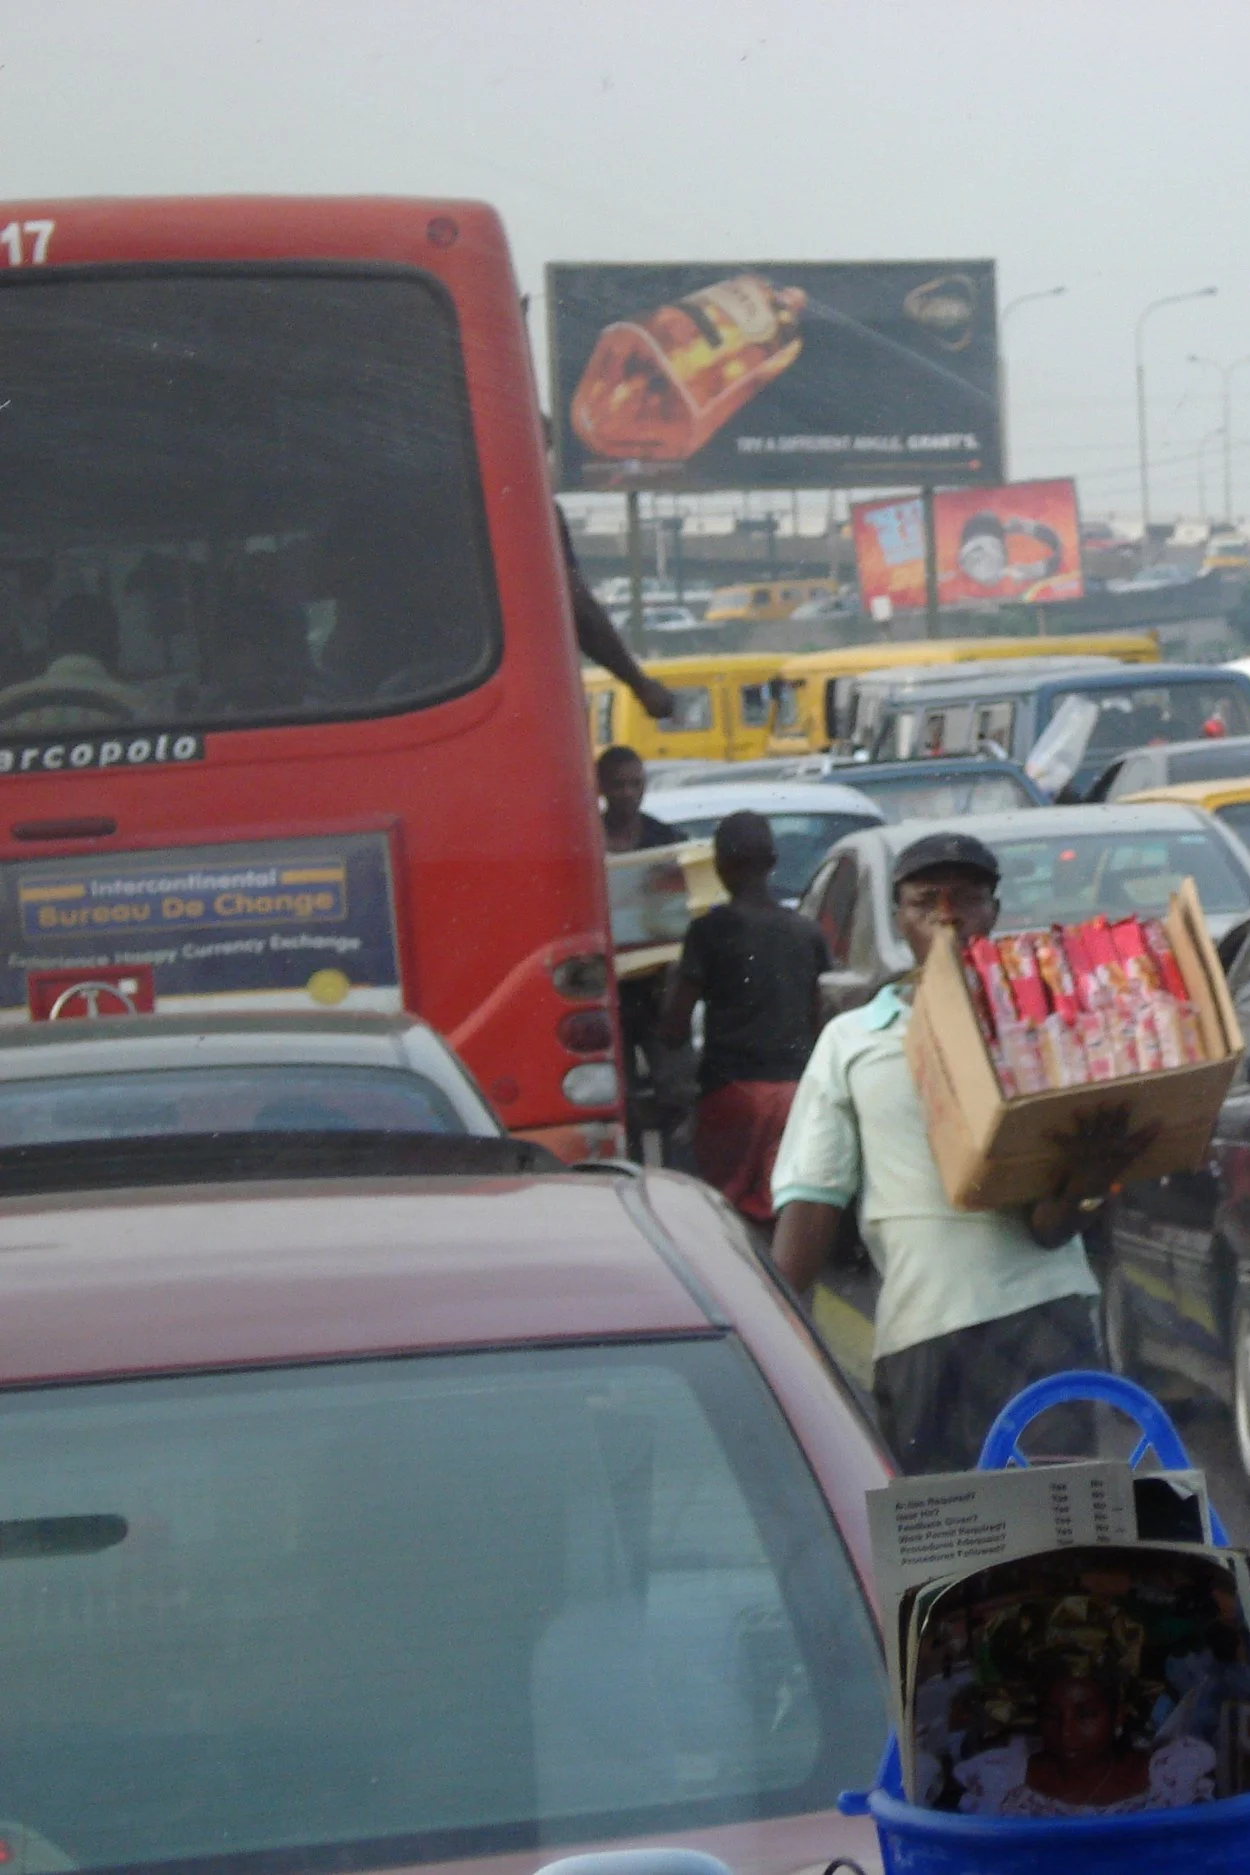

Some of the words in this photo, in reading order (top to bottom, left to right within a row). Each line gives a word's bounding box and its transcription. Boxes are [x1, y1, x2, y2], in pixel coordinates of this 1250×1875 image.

[0, 219, 57, 267] 17
[90, 868, 278, 897] Intercontinental
[38, 902, 150, 928] Bureau
[161, 896, 206, 919] De
[213, 891, 335, 917] Change
[269, 933, 361, 954] Exchange
